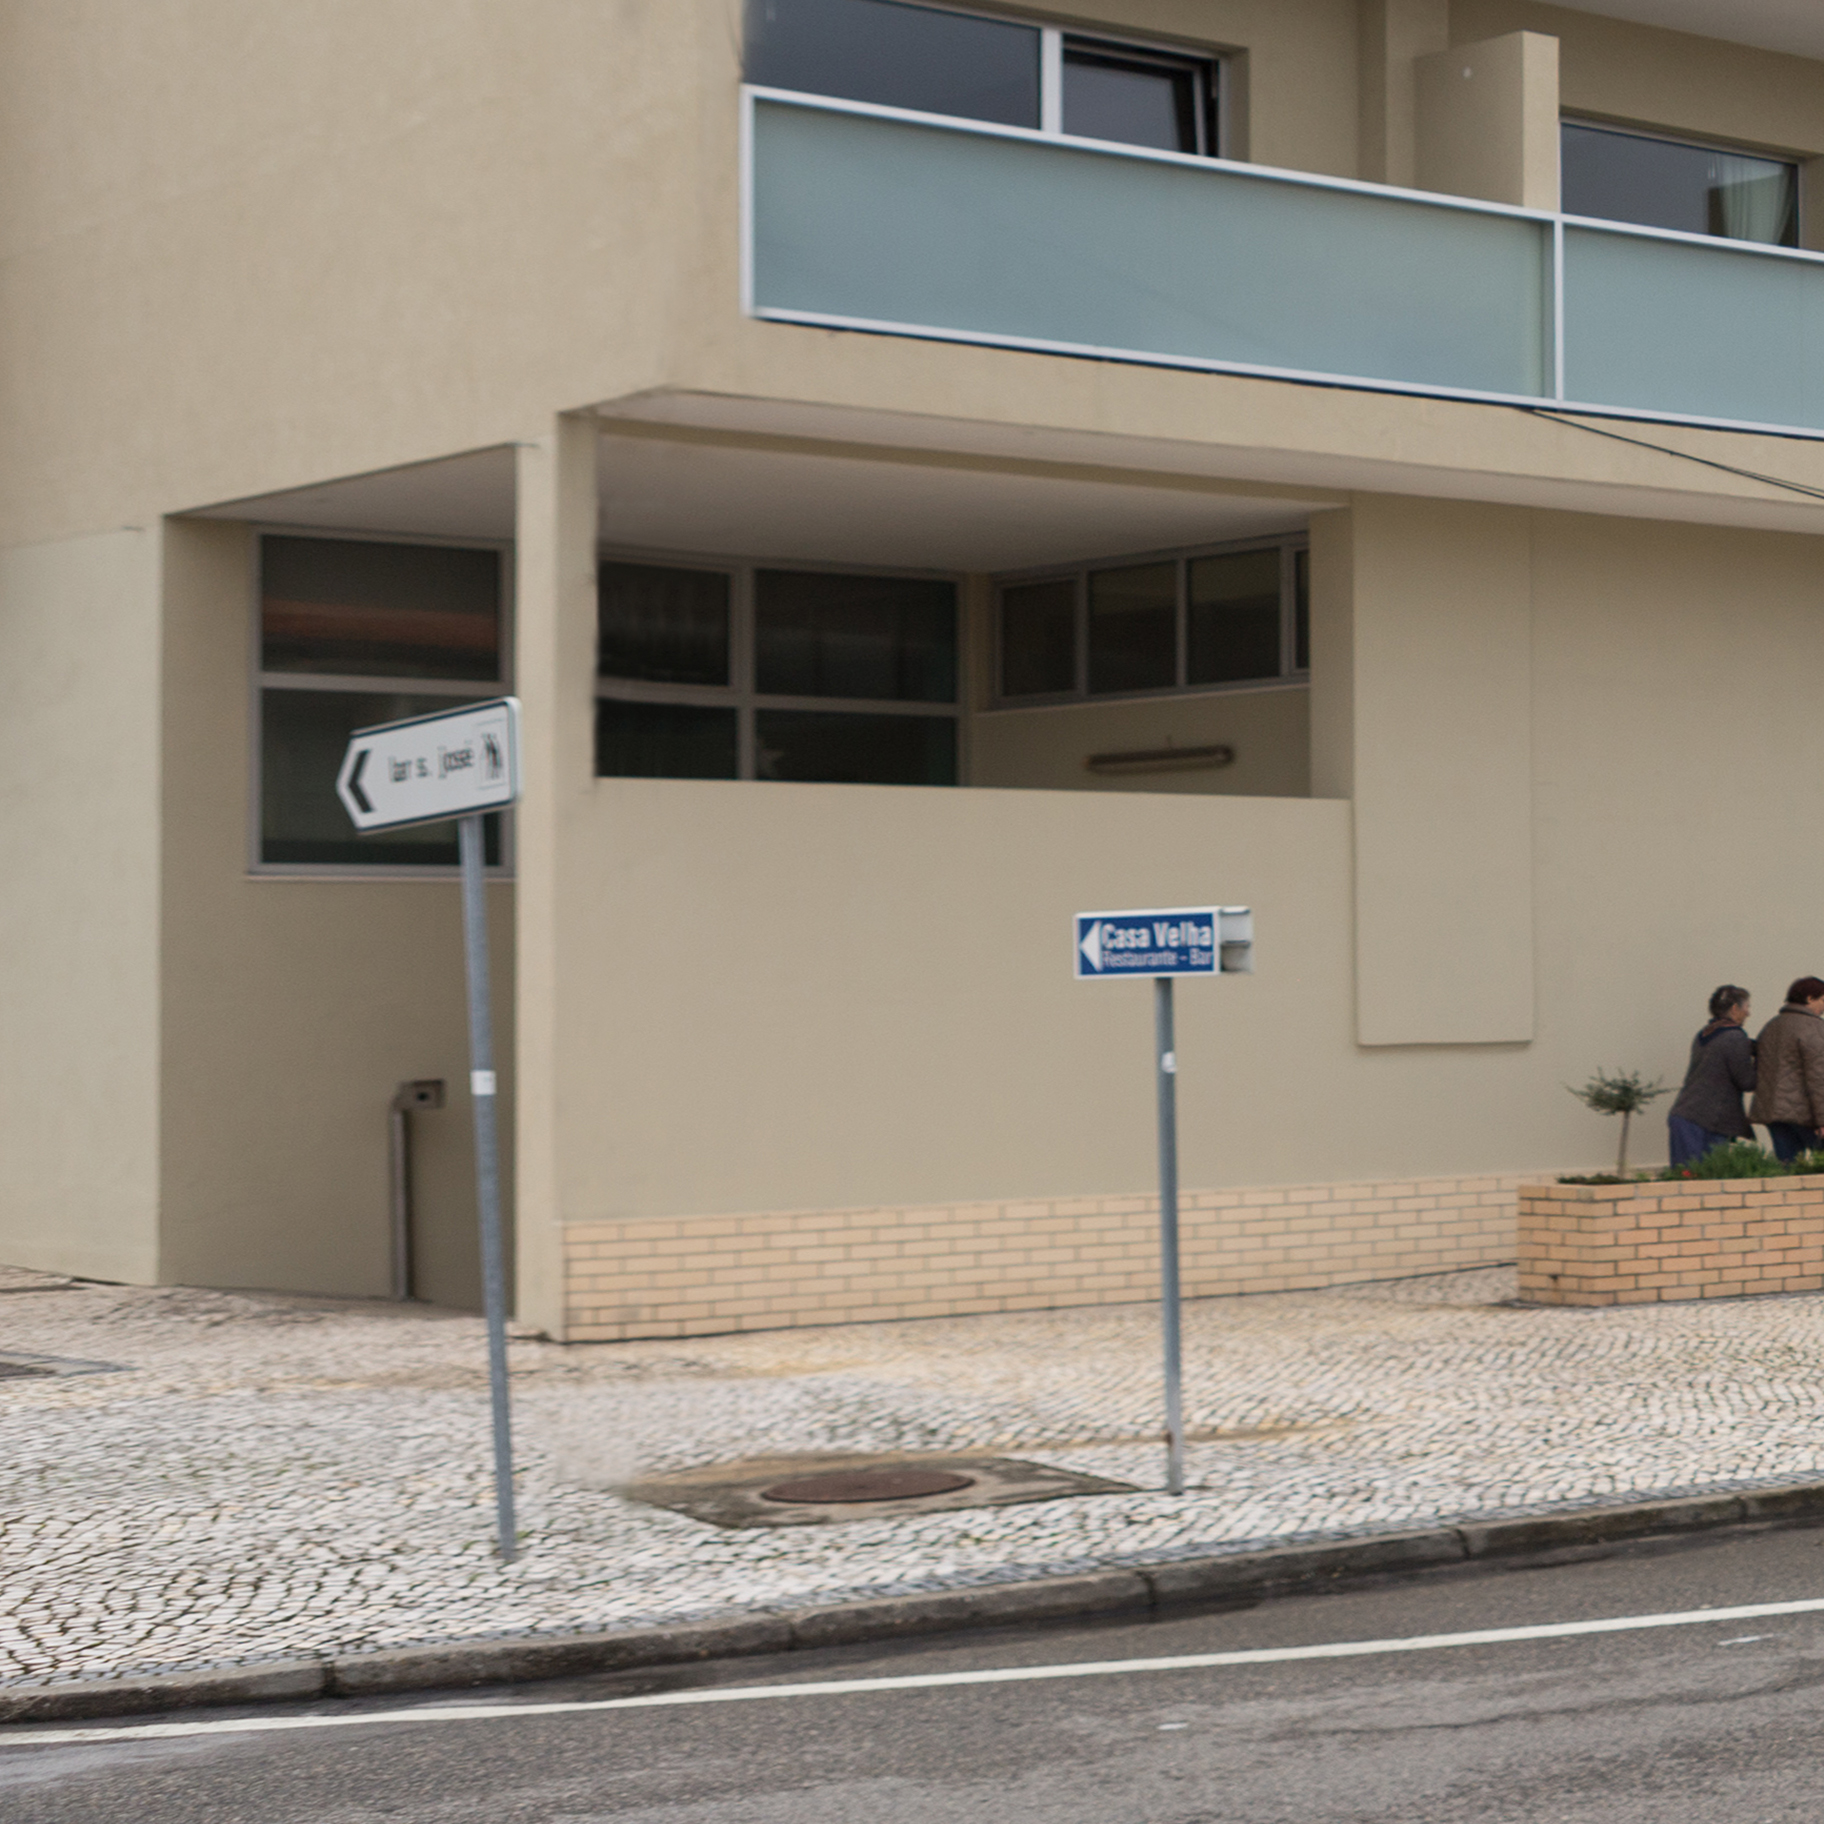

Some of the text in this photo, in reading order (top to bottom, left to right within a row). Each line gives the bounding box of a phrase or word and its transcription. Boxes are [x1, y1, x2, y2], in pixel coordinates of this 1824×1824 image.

[1101, 920, 1212, 949] Casa Velha
[1189, 948, 1213, 966] Bar
